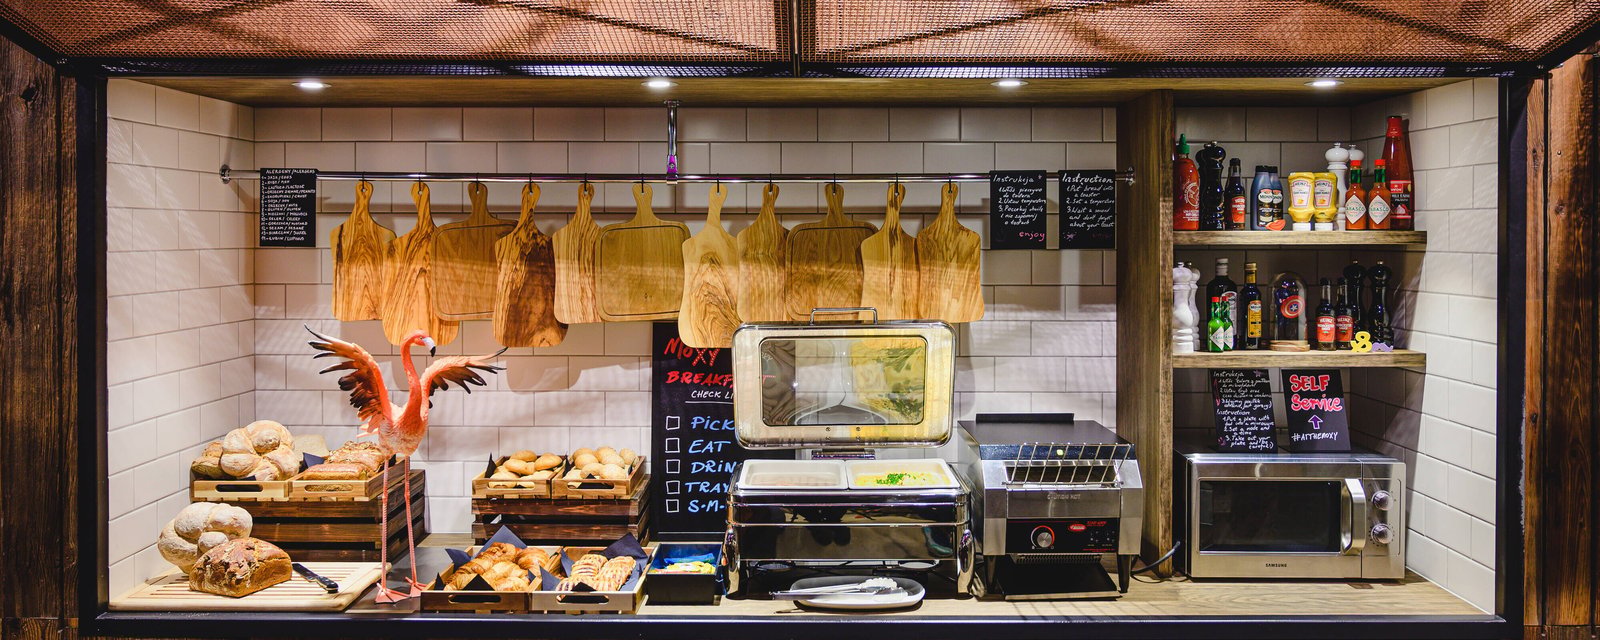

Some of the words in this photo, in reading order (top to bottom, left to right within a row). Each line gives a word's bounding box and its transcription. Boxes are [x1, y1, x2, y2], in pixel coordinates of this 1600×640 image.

[1062, 173, 1113, 183] Instruction
[1019, 231, 1045, 242] enjoy
[1290, 374, 1330, 392] SELF
[691, 390, 721, 398] CHECK
[1291, 394, 1342, 412] Service
[688, 440, 731, 454] EAT
